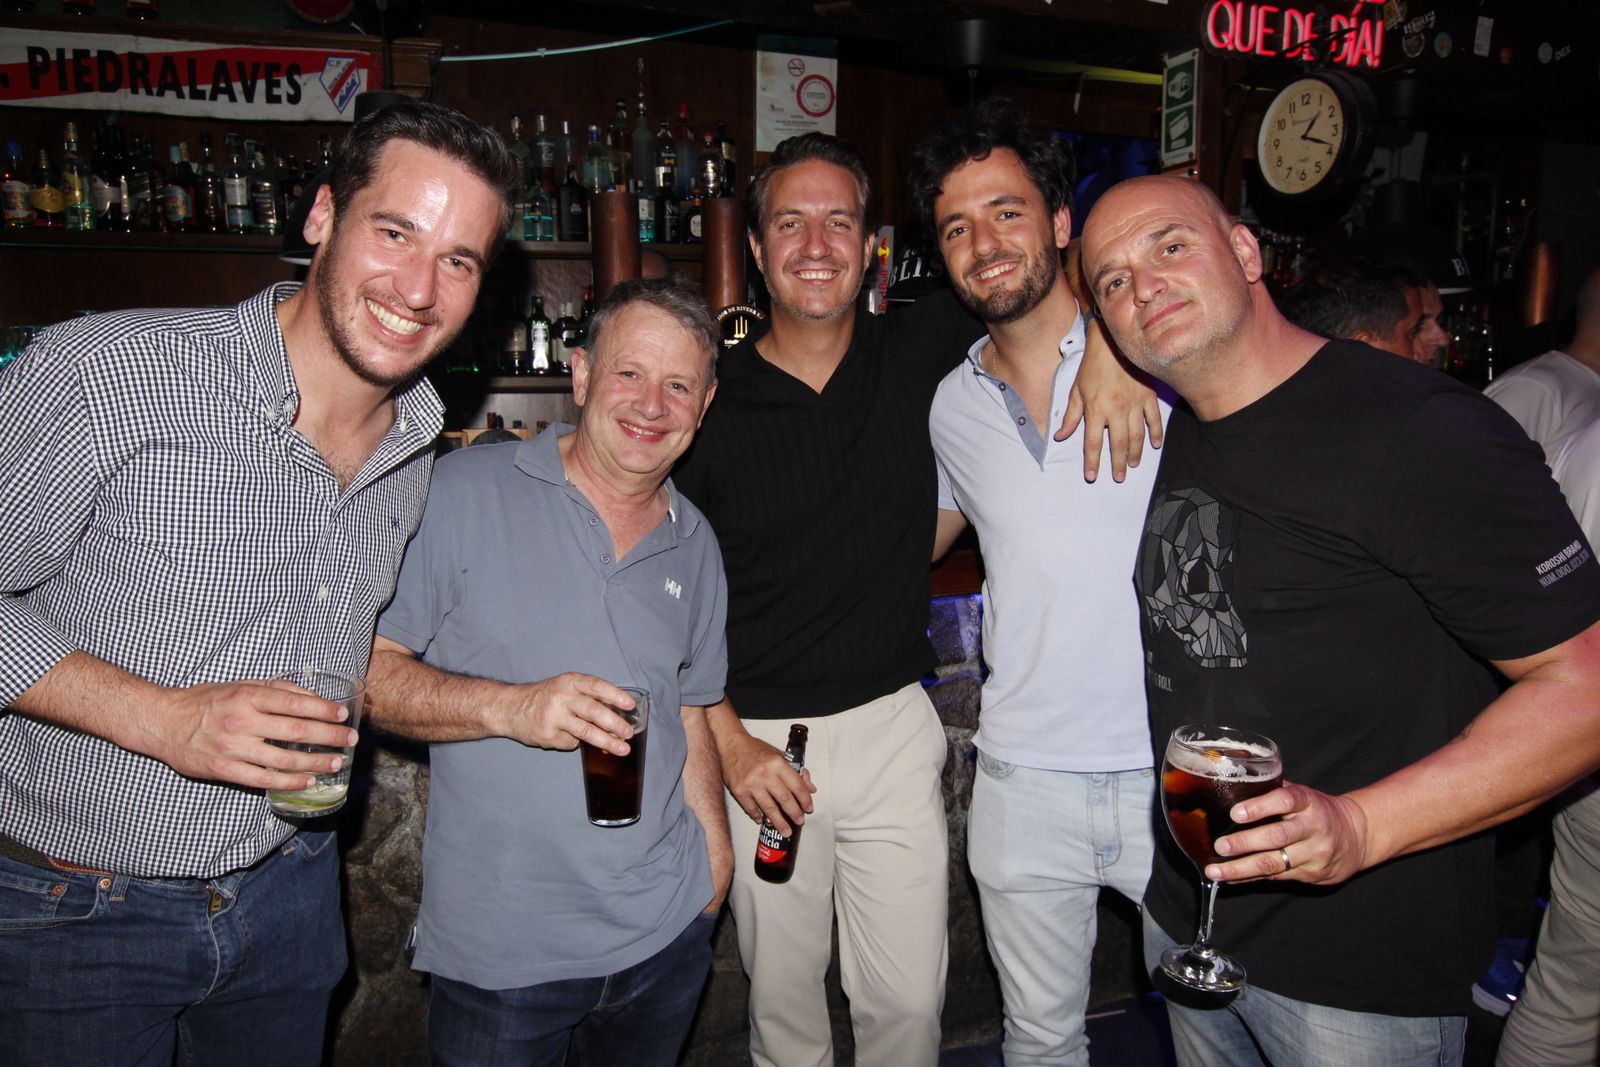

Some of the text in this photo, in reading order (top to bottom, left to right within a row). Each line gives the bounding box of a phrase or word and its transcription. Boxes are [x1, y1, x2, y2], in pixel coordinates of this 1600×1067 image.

[1206, 0, 1279, 56] QUE
[27, 46, 302, 106] PIEDRALAVES
[1301, 93, 1311, 106] 12
[1289, 102, 1296, 114] 11
[1328, 105, 1335, 118] 2
[1277, 118, 1286, 130] 10
[1332, 124, 1339, 136] 3
[1274, 139, 1280, 150] 9
[1326, 145, 1333, 157] 4
[1276, 156, 1283, 168] 8
[1315, 161, 1322, 173] 5
[1286, 167, 1293, 179] 7
[1300, 169, 1307, 181] 6
[736, 306, 757, 315] RIVERA
[1535, 551, 1567, 575] KOROSHI
